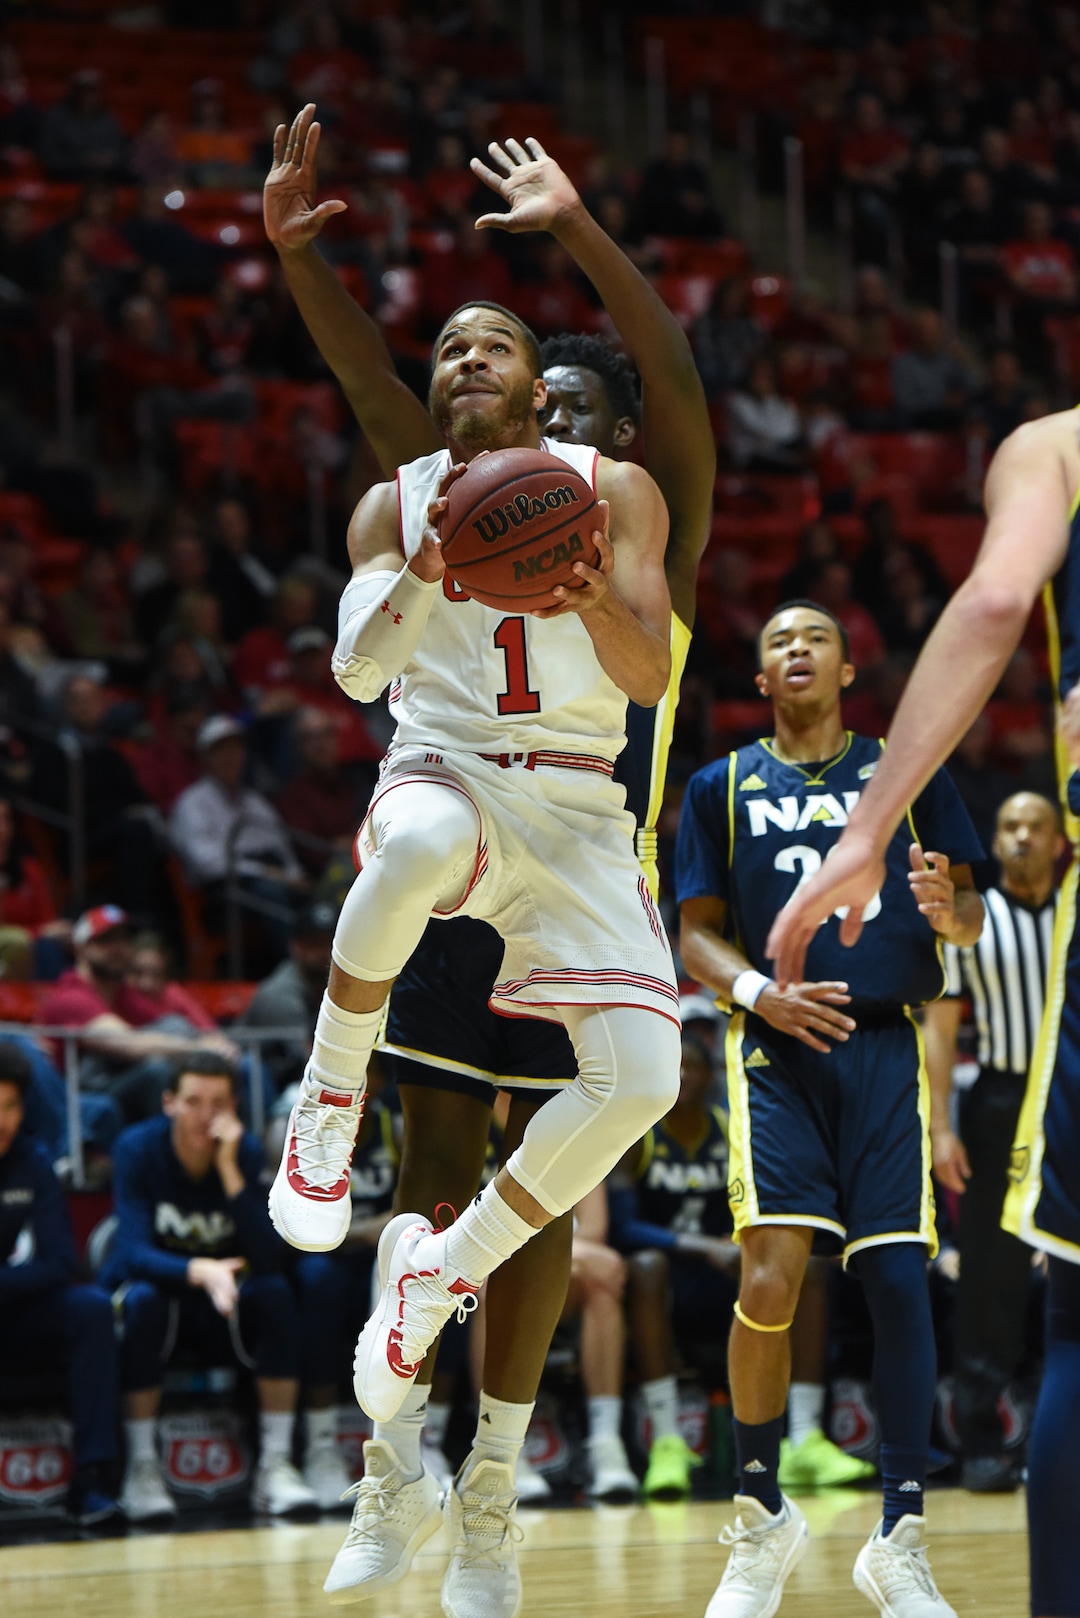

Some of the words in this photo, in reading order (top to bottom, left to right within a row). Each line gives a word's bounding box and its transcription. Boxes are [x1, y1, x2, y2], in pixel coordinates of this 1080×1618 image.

[471, 484, 579, 544] Wilson
[512, 531, 584, 582] NCAA
[493, 616, 541, 716] 1
[774, 845, 882, 925] 2
[6, 1451, 62, 1486] 66
[177, 1443, 230, 1477] 66
